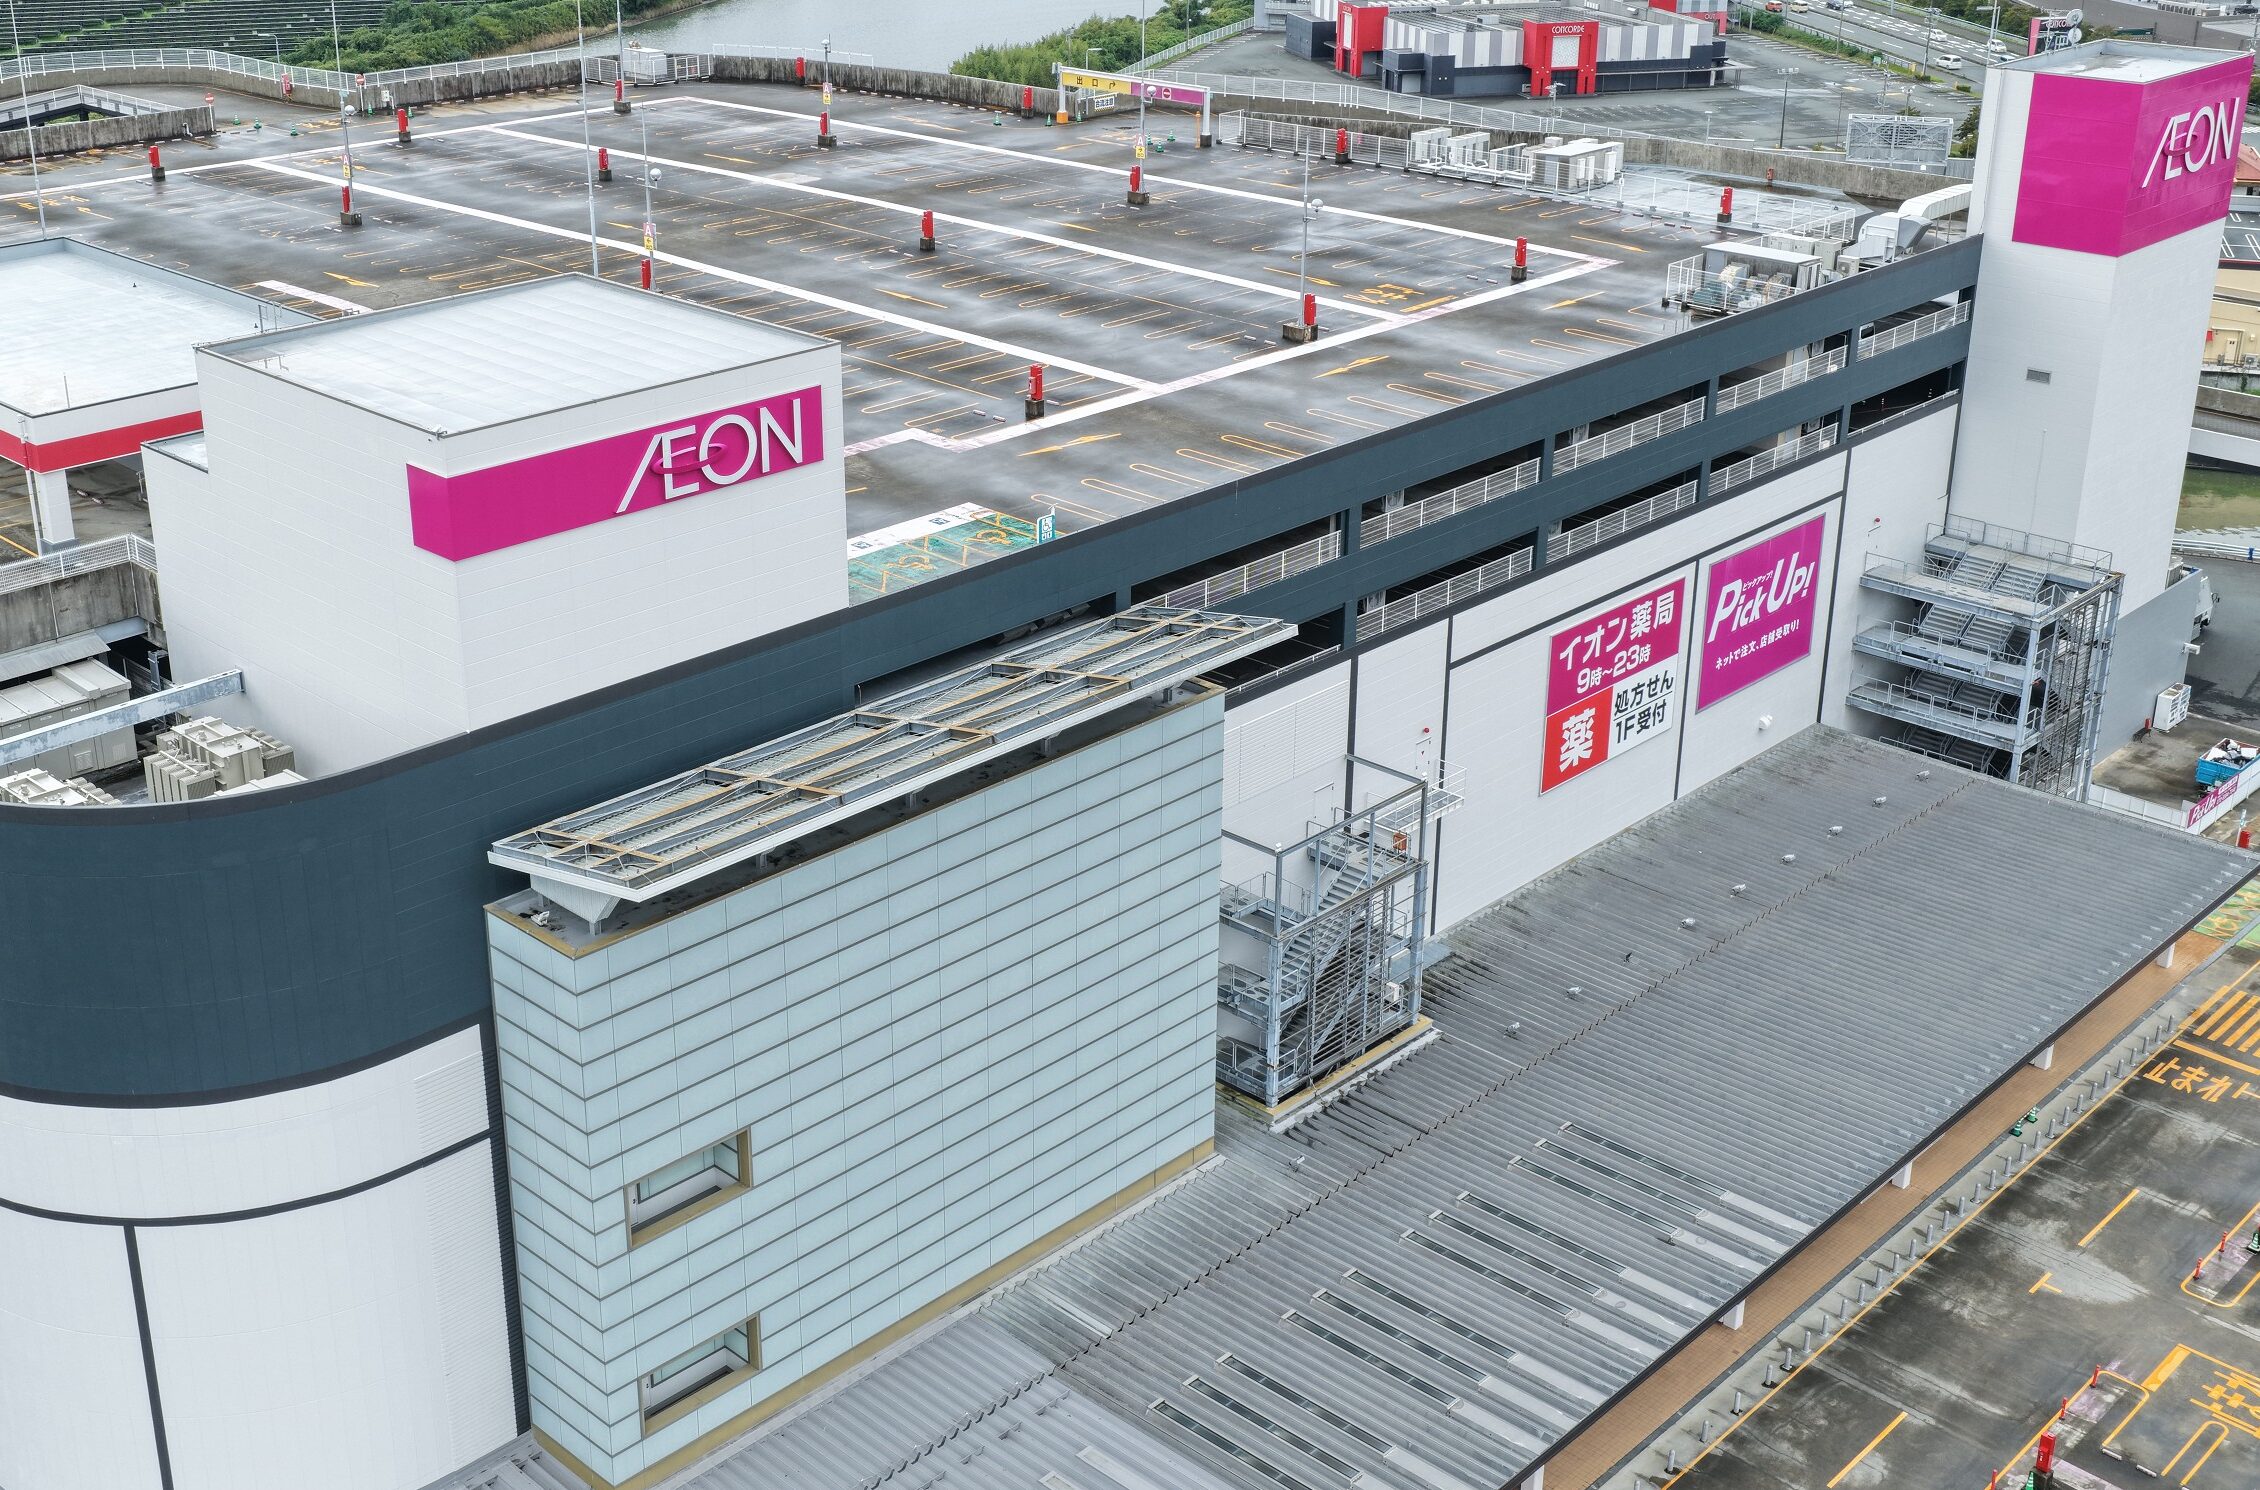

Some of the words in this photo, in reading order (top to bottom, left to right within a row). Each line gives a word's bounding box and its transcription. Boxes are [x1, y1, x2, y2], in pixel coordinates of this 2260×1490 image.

[1551, 25, 1585, 34] CONCORDE
[1076, 75, 1099, 88] 出口
[1559, 589, 1675, 671] イオン薬局
[1613, 669, 1674, 717] 処方せん
[1558, 707, 1597, 773] 薬
[1615, 698, 1667, 744] 1F受付
[2143, 1057, 2233, 1103] 止まれ
